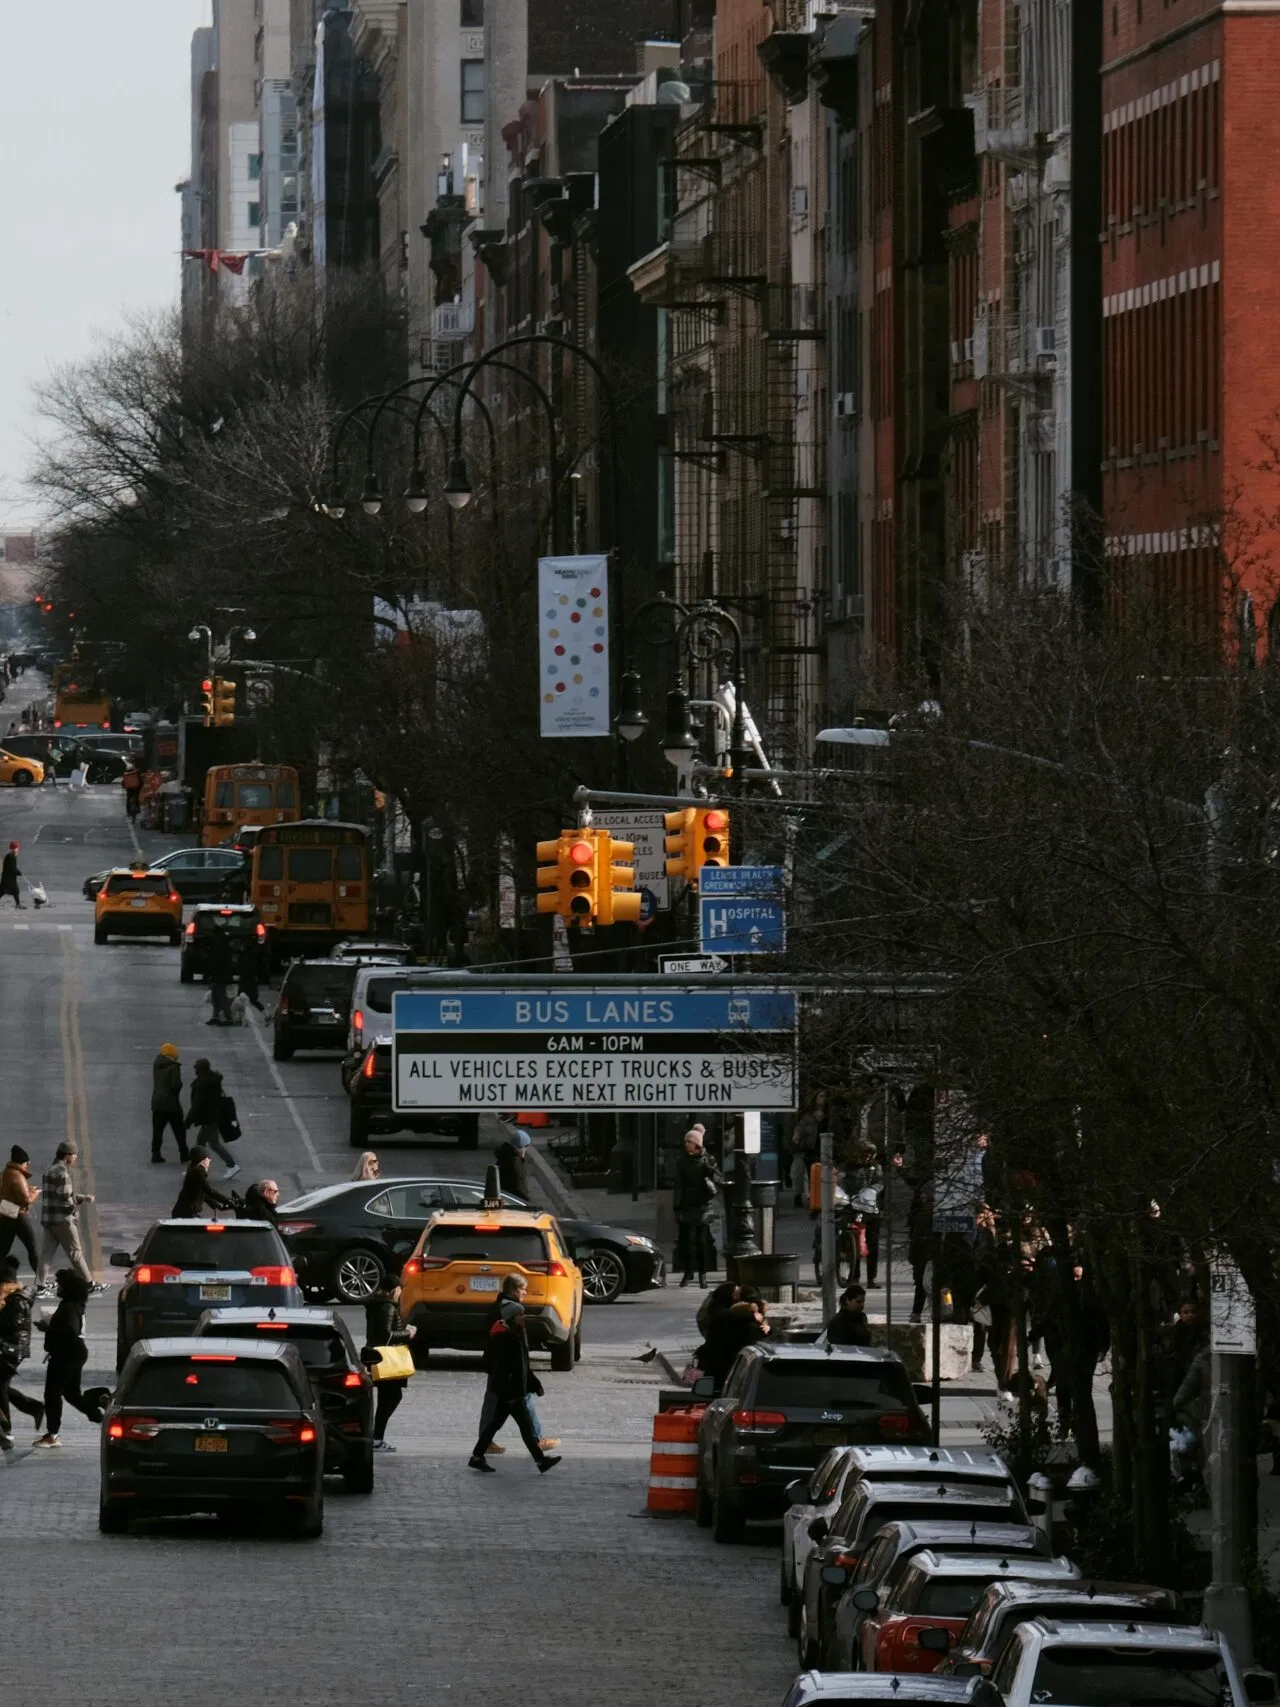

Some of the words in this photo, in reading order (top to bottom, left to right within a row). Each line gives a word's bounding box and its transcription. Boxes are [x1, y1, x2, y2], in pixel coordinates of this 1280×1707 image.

[605, 815, 630, 825] LOCAL
[709, 908, 776, 938] HOSPITAL
[670, 962, 691, 972] ONE
[701, 960, 723, 971] WAY
[515, 1001, 569, 1023] BUS
[586, 1001, 674, 1023] LANES
[547, 1036, 583, 1051] 6AM
[602, 1036, 644, 1051] 10PM
[409, 1061, 442, 1078] ALL
[450, 1061, 538, 1078] VEHICLES
[546, 1061, 613, 1078] EXCEPT
[621, 1060, 692, 1078] TRUCKS
[700, 1060, 714, 1078] &
[723, 1060, 782, 1078] BUSES
[459, 1084, 507, 1101] MUST
[515, 1084, 565, 1101] MAKE
[572, 1084, 617, 1101] NEXT
[624, 1084, 678, 1101] RIGHT
[684, 1084, 732, 1101] TURN
[821, 1410, 844, 1421] Jeep
